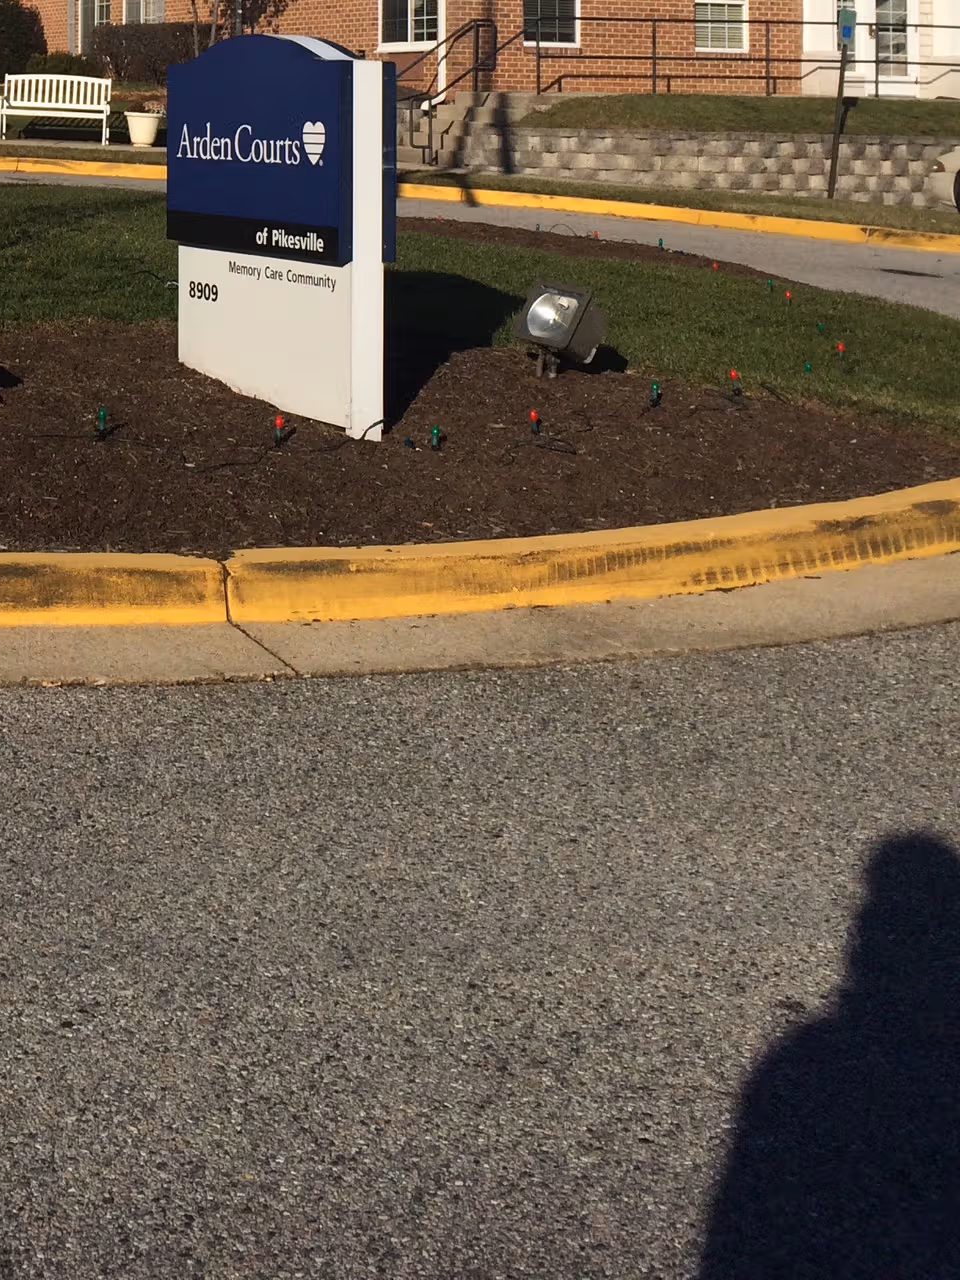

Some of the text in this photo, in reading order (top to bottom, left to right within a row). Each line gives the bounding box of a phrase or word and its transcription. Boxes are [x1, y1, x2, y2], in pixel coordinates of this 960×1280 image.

[176, 121, 301, 165] Arden Courts
[256, 227, 324, 252] of Pikesville
[228, 261, 337, 292] Memory Care Community
[189, 281, 219, 302] 8909
